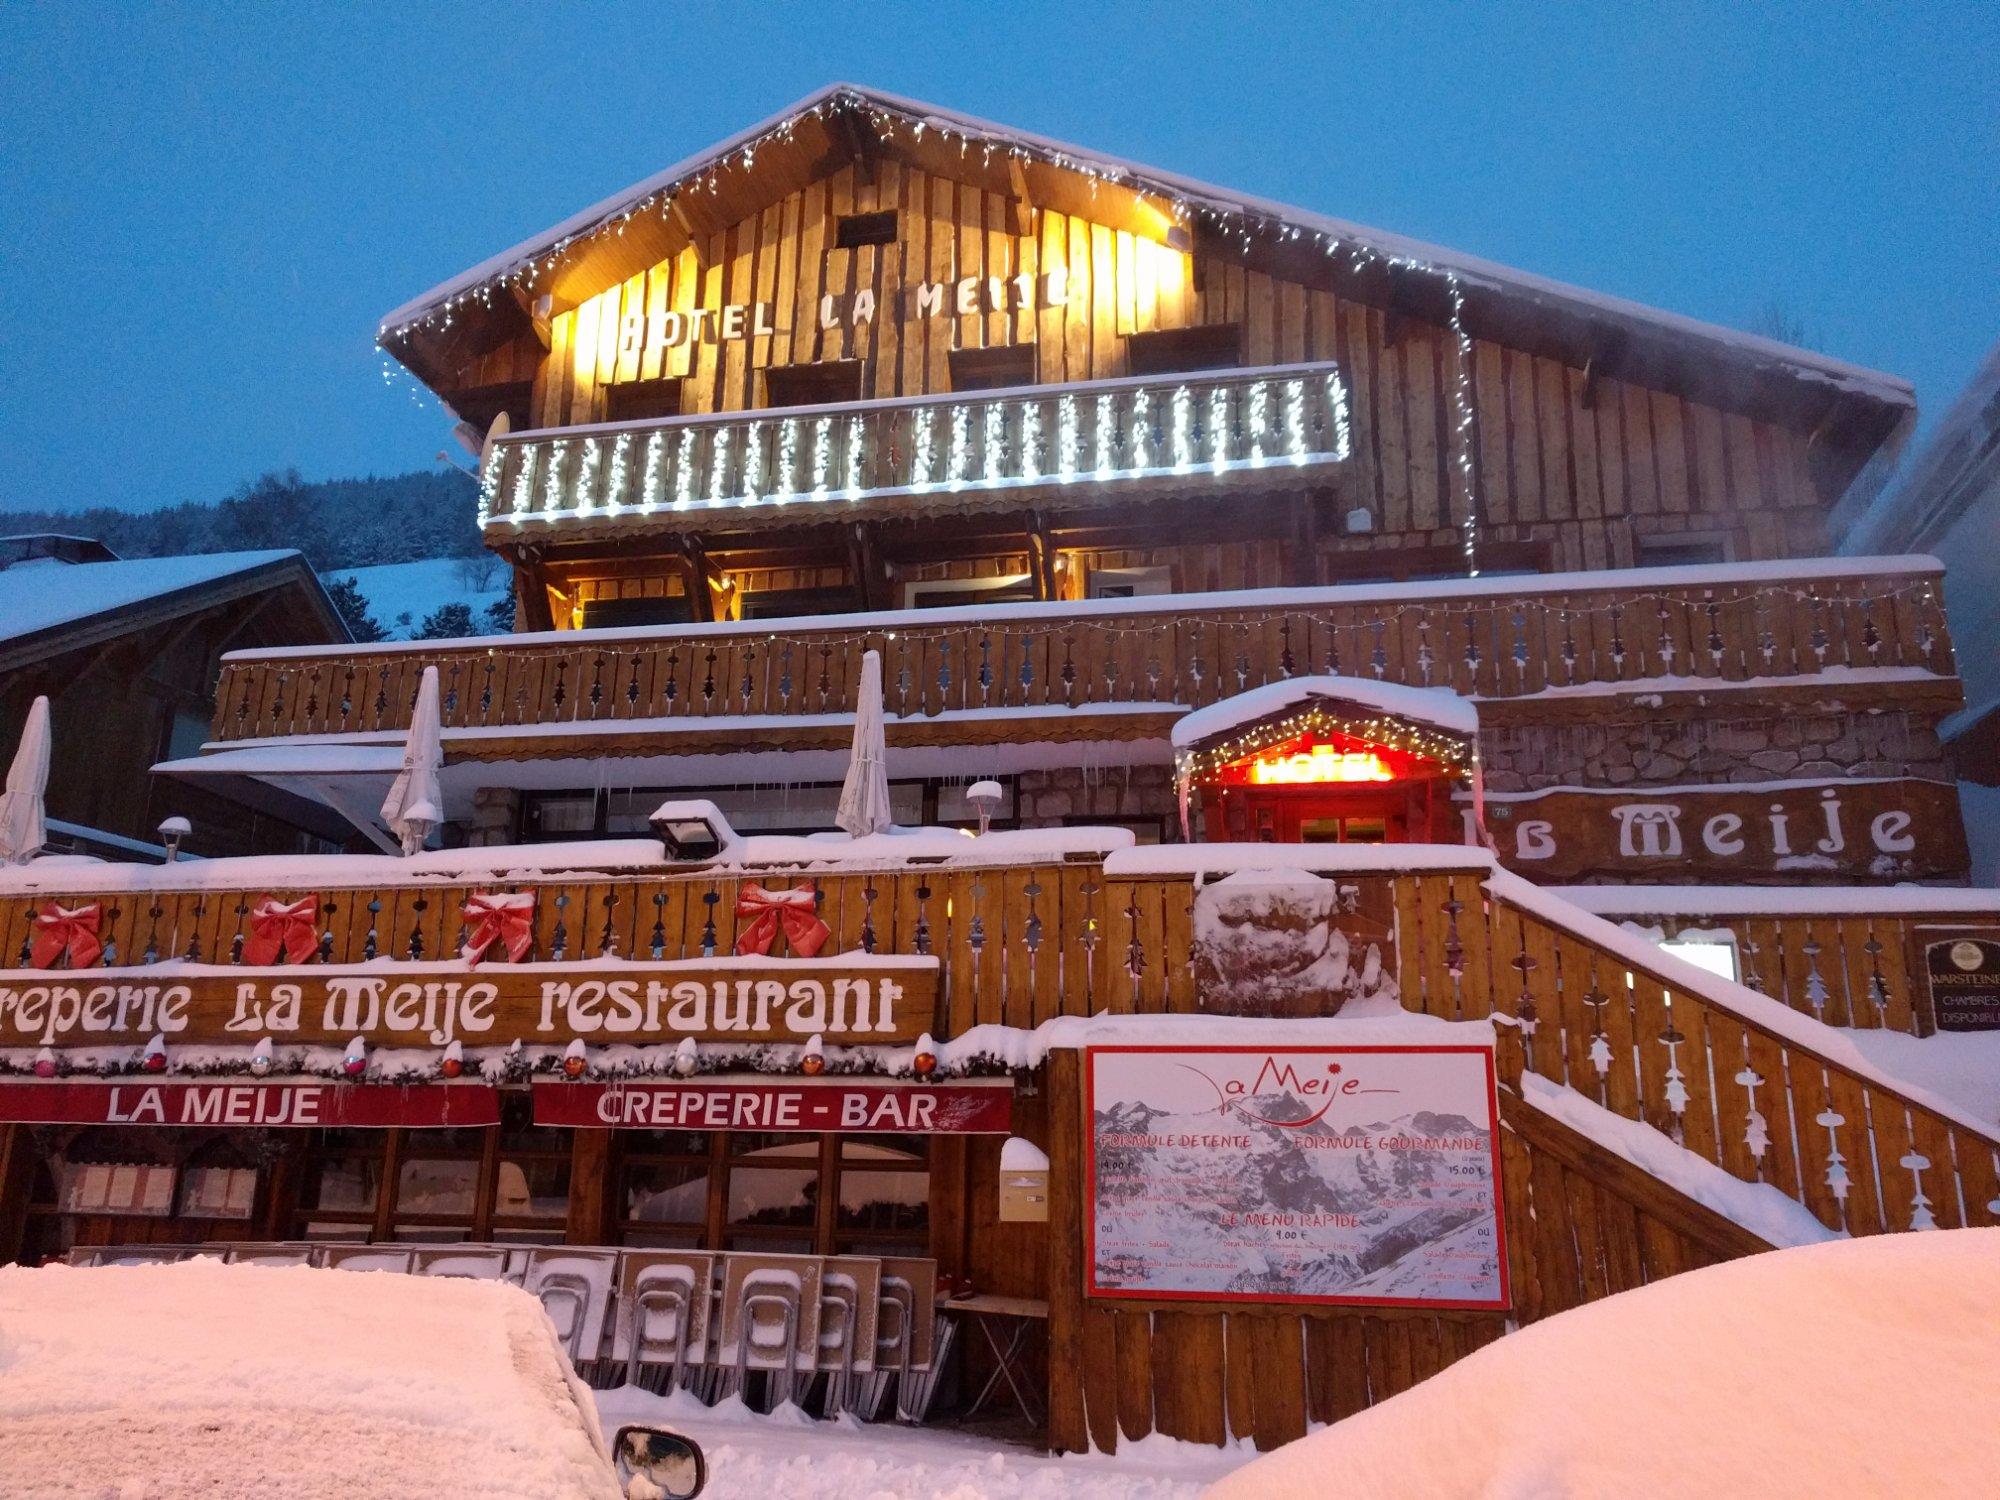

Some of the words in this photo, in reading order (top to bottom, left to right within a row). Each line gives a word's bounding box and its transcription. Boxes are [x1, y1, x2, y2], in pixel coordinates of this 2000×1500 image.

[620, 303, 773, 350] HOTEL
[821, 288, 875, 330] LA
[224, 983, 302, 1032] La
[536, 977, 904, 1034] restaurant
[1943, 1013, 2000, 1023] DISPONIBL
[106, 1087, 166, 1123] LA
[181, 1086, 324, 1124] MEIJE
[597, 1090, 803, 1127] CREPERIE
[841, 1093, 938, 1128] BAR
[1101, 1134, 1176, 1147] FORMULE
[1179, 1134, 1252, 1148] DETENTE
[1295, 1135, 1373, 1150] FORMULE
[1379, 1136, 1484, 1151] GOURMANDE
[1221, 1212, 1239, 1226] LE
[1245, 1213, 1295, 1226] MENU
[1300, 1213, 1361, 1228] RAPIDE
[1276, 1229, 1298, 1240] 9.00
